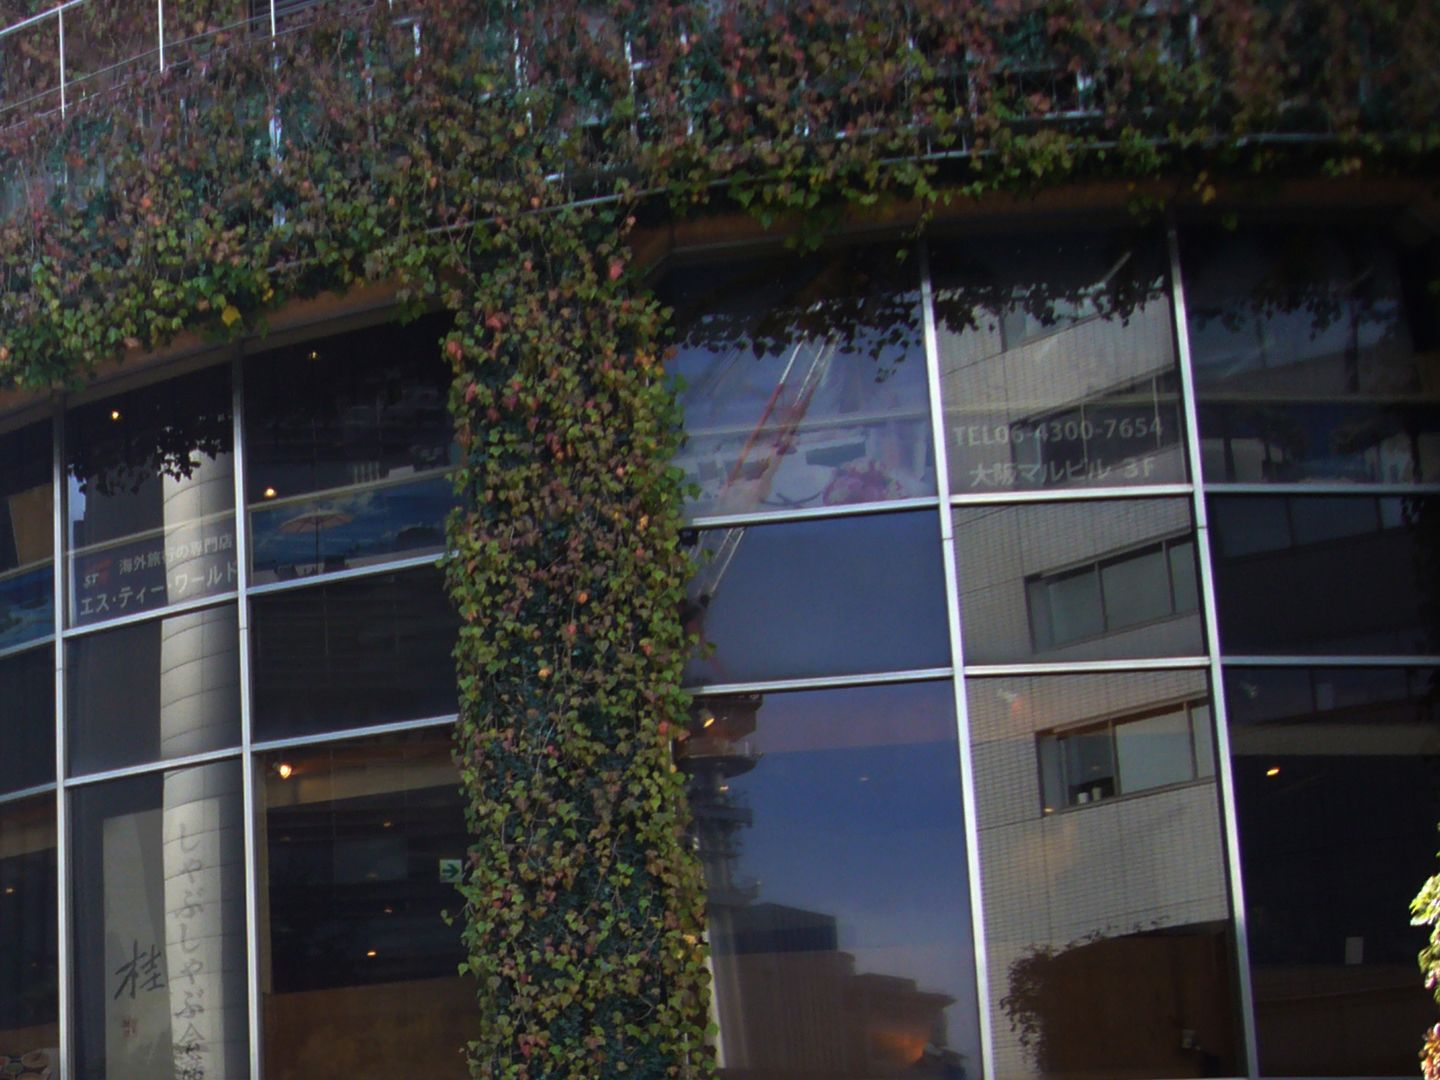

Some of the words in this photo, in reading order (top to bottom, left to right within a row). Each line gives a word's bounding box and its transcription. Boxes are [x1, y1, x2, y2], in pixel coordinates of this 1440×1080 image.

[952, 415, 1163, 446] TEL06-4300-7654
[968, 458, 1111, 488] 大阪マルビル
[118, 534, 233, 575] 海外旅行の専門店
[113, 938, 166, 1001] 桂
